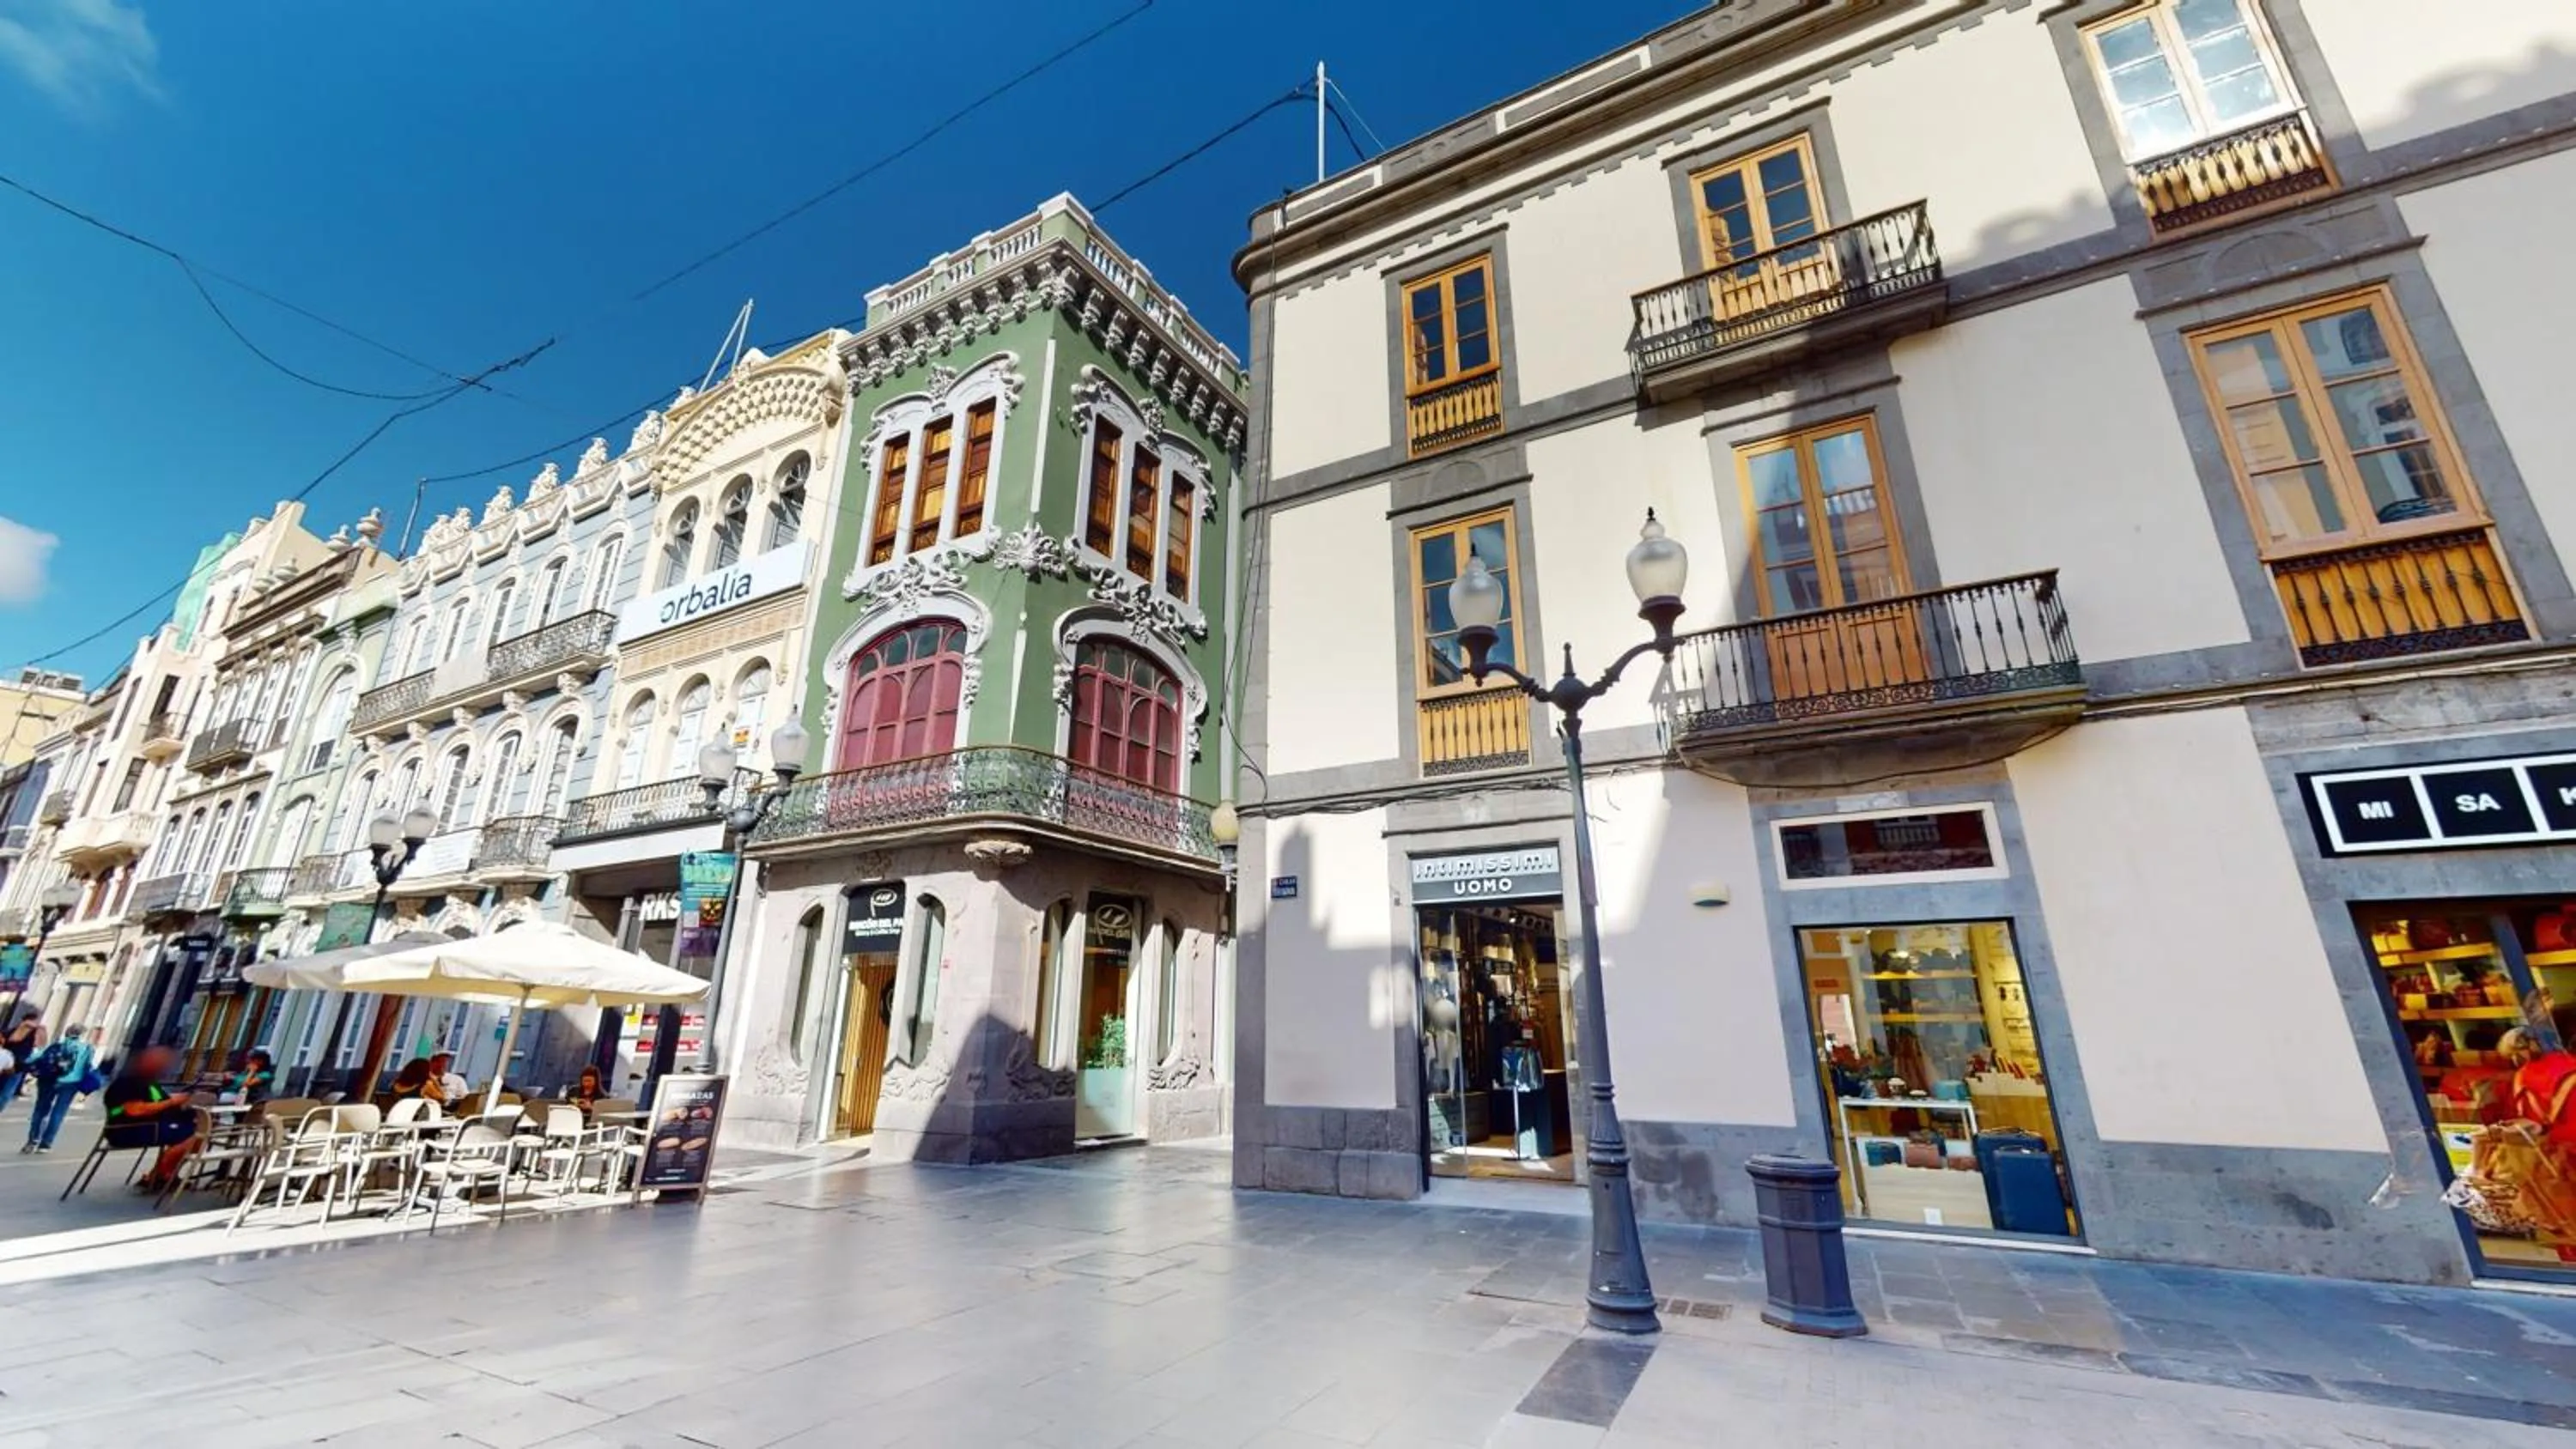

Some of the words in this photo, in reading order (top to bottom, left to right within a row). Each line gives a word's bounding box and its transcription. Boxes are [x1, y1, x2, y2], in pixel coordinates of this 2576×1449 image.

[659, 568, 752, 623] orbalia
[2358, 801, 2395, 820] MI
[2455, 793, 2502, 813] SA
[1415, 852, 1553, 878] intimissimi
[1454, 877, 1512, 895] UOMO
